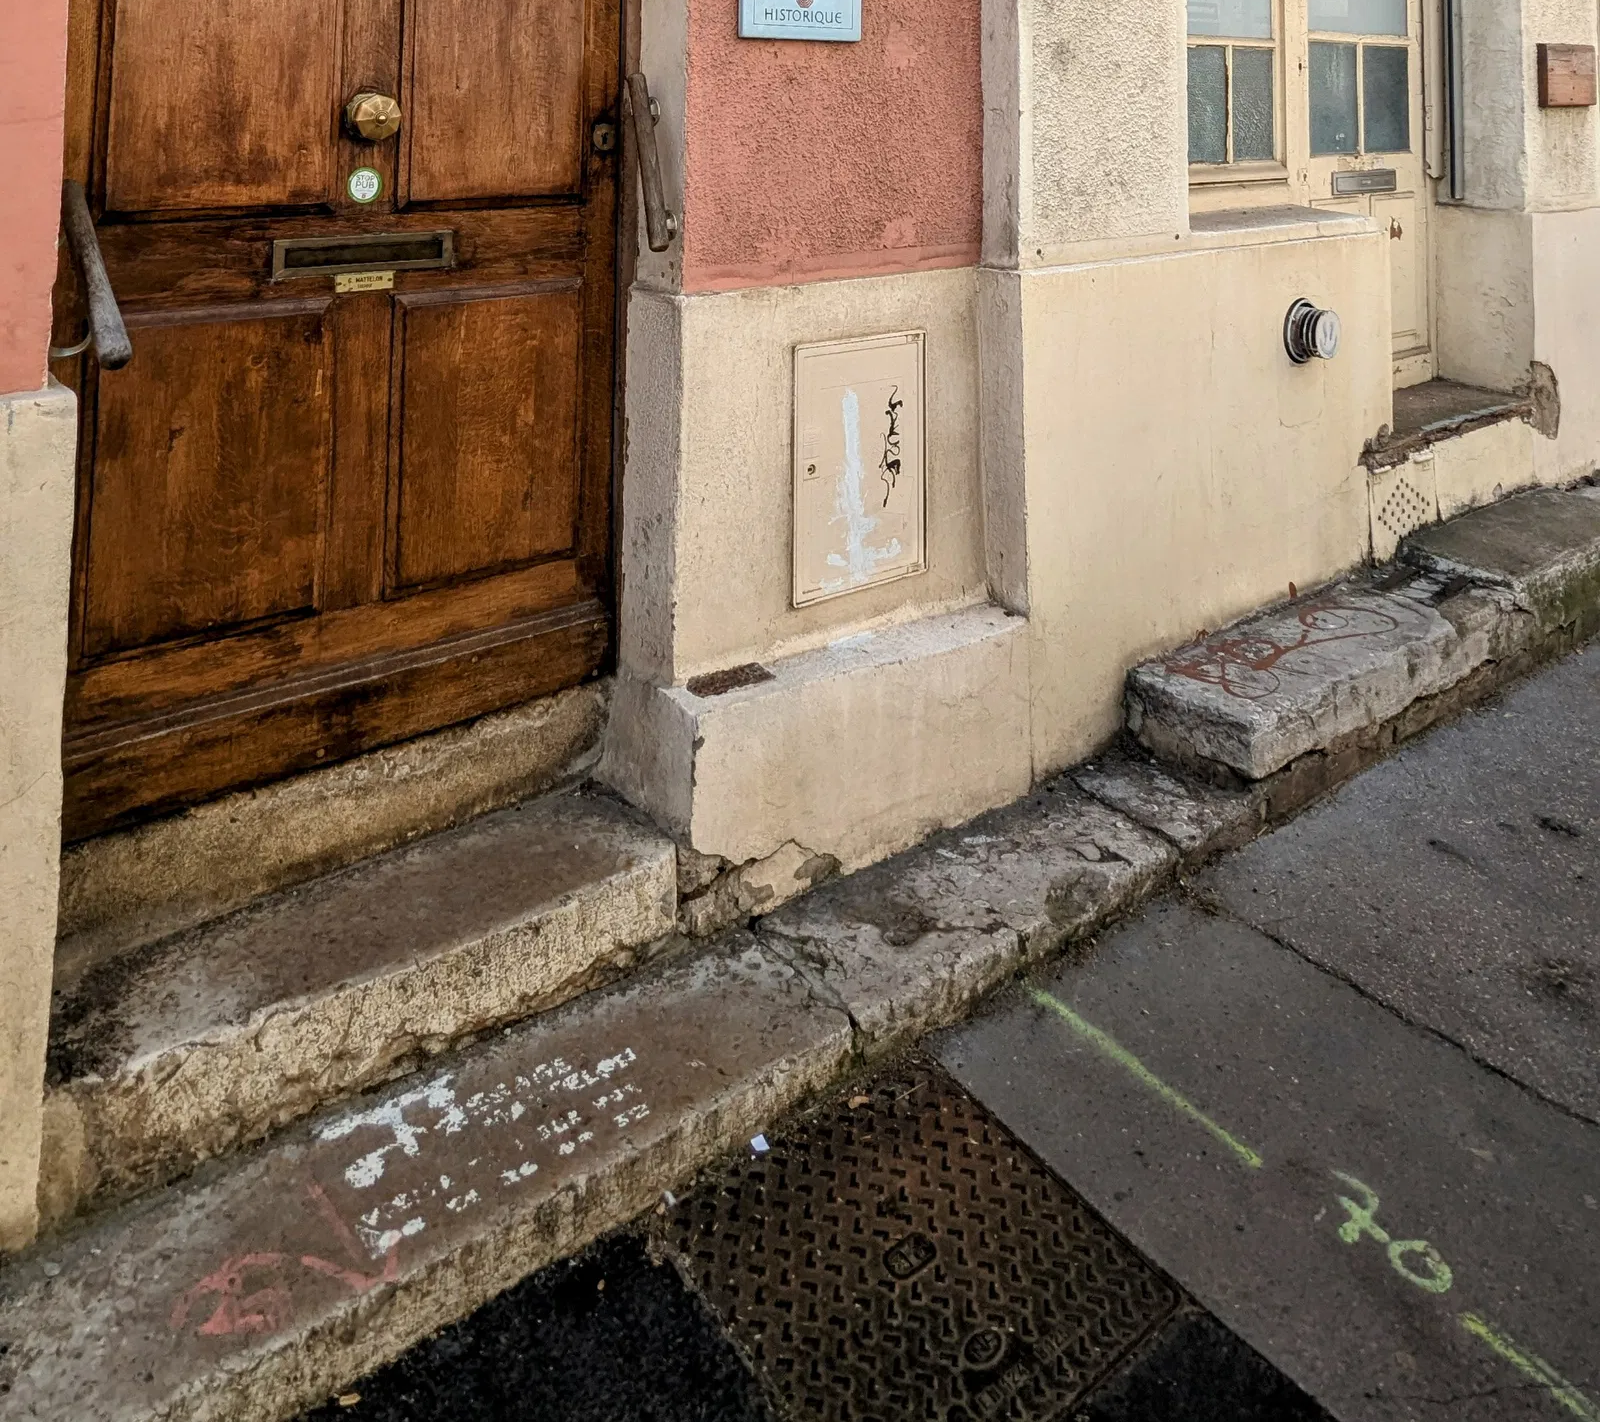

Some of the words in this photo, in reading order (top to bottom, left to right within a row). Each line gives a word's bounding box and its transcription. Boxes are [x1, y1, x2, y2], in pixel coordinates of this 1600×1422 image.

[764, 7, 843, 25] HISTORIQUE
[355, 174, 375, 182] STOP
[354, 180, 375, 189] PUB
